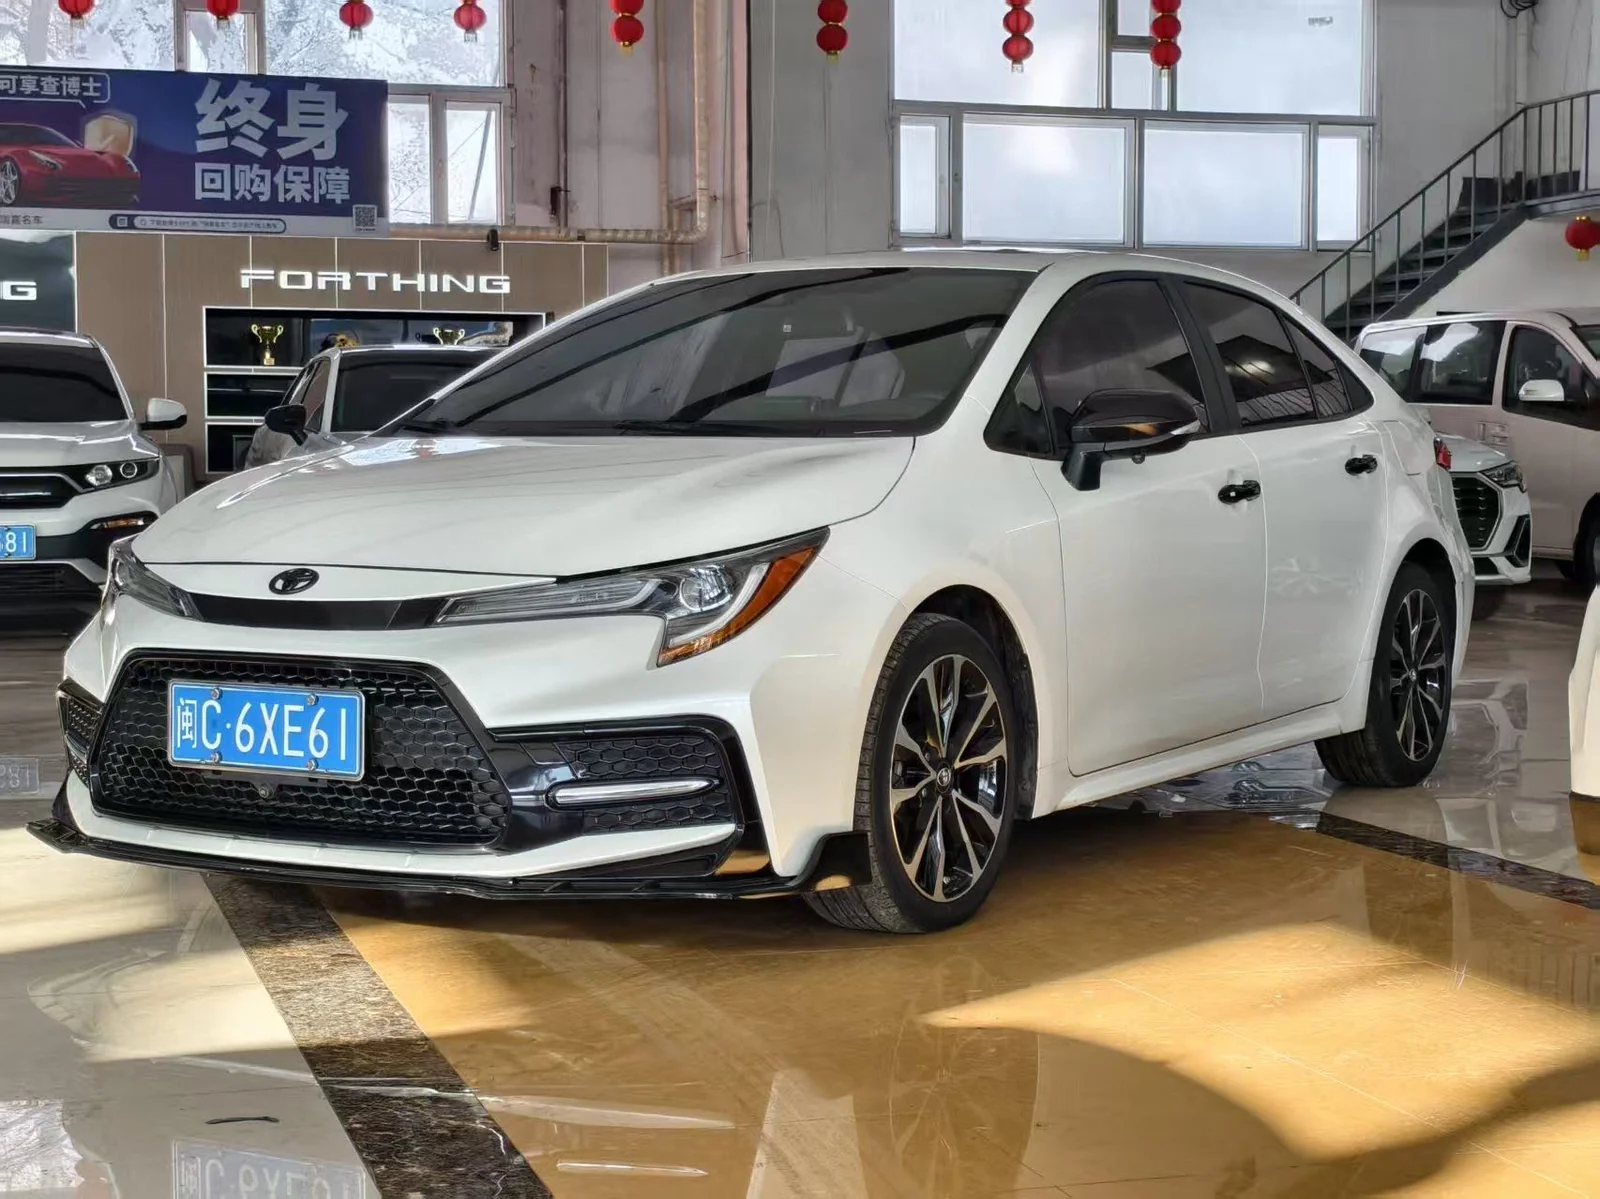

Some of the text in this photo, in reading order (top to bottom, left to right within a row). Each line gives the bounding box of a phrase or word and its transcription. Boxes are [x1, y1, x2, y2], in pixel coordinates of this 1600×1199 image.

[0, 74, 102, 97] 可享查博士
[194, 79, 349, 162] 终身
[194, 162, 352, 205] 回购保障
[0, 281, 37, 301] G
[240, 268, 511, 294] FORTHING
[0, 531, 27, 553] 81
